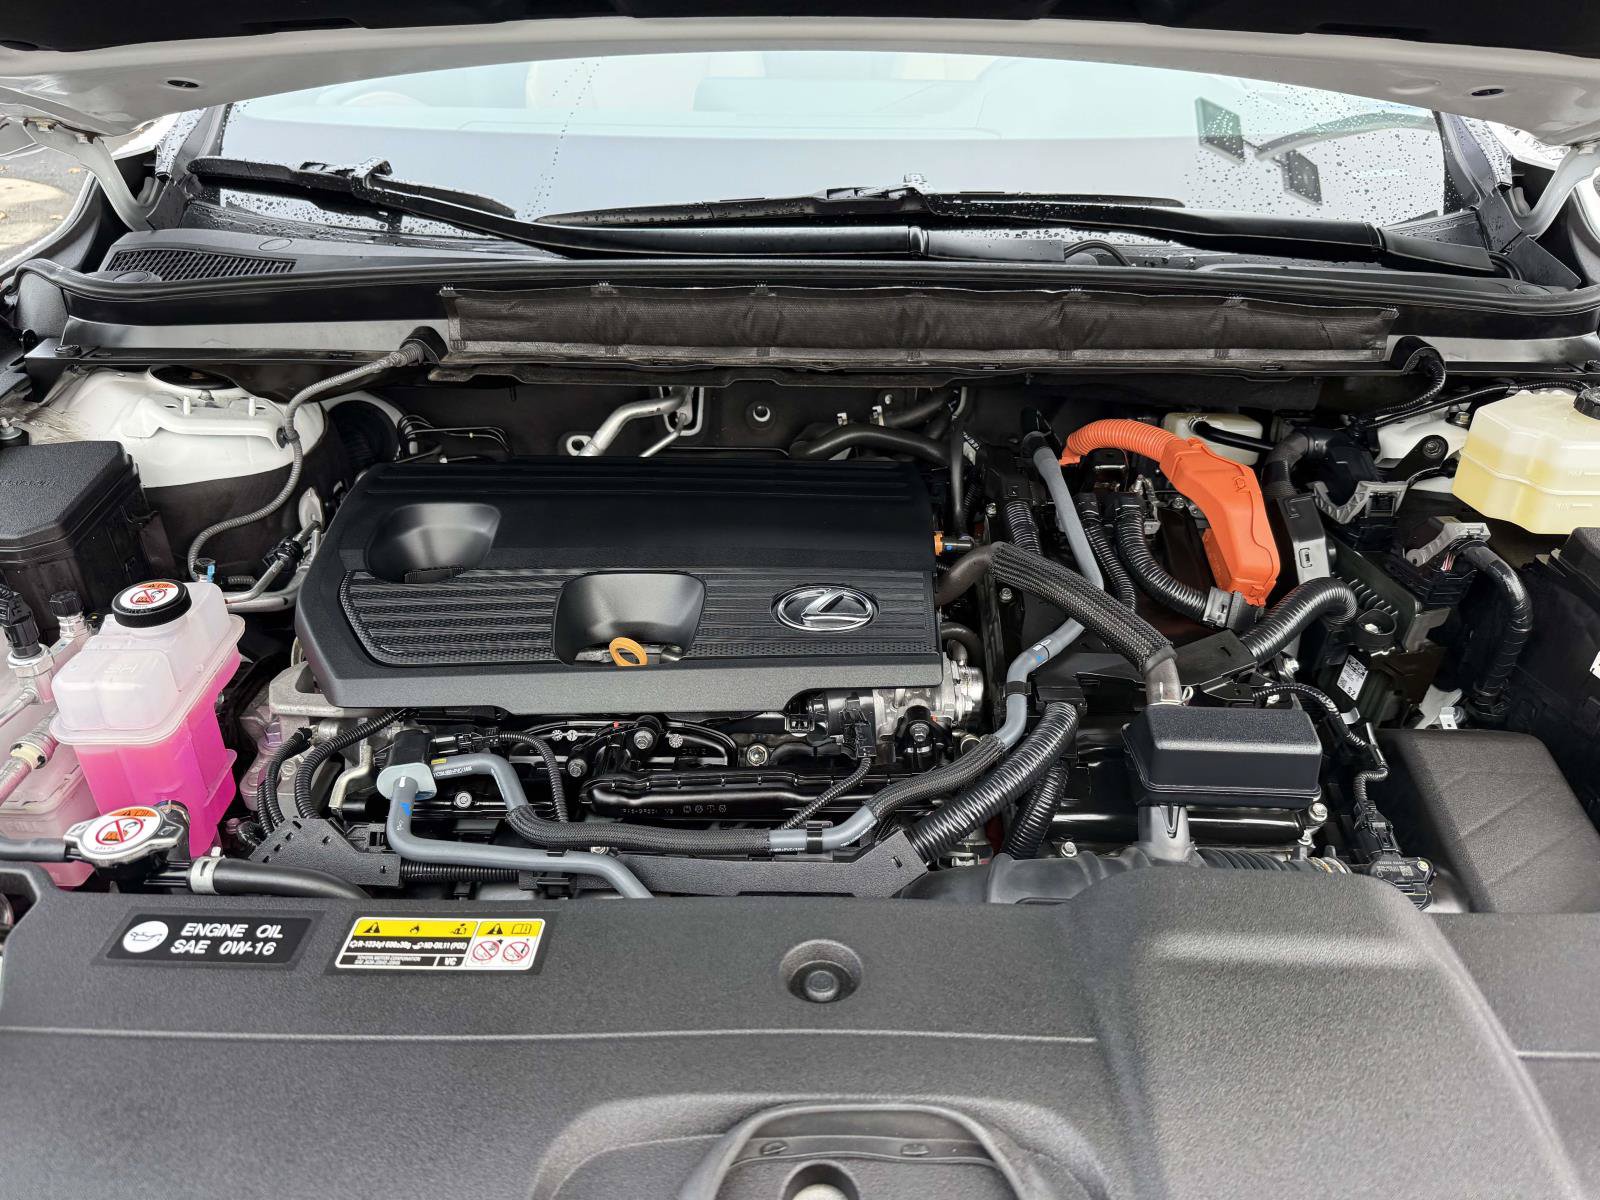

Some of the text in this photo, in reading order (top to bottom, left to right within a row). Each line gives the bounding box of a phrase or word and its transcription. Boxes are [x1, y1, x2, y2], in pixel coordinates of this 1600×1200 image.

[180, 922, 284, 939] ENGINE OIL
[170, 939, 277, 956] SAE 0W-16
